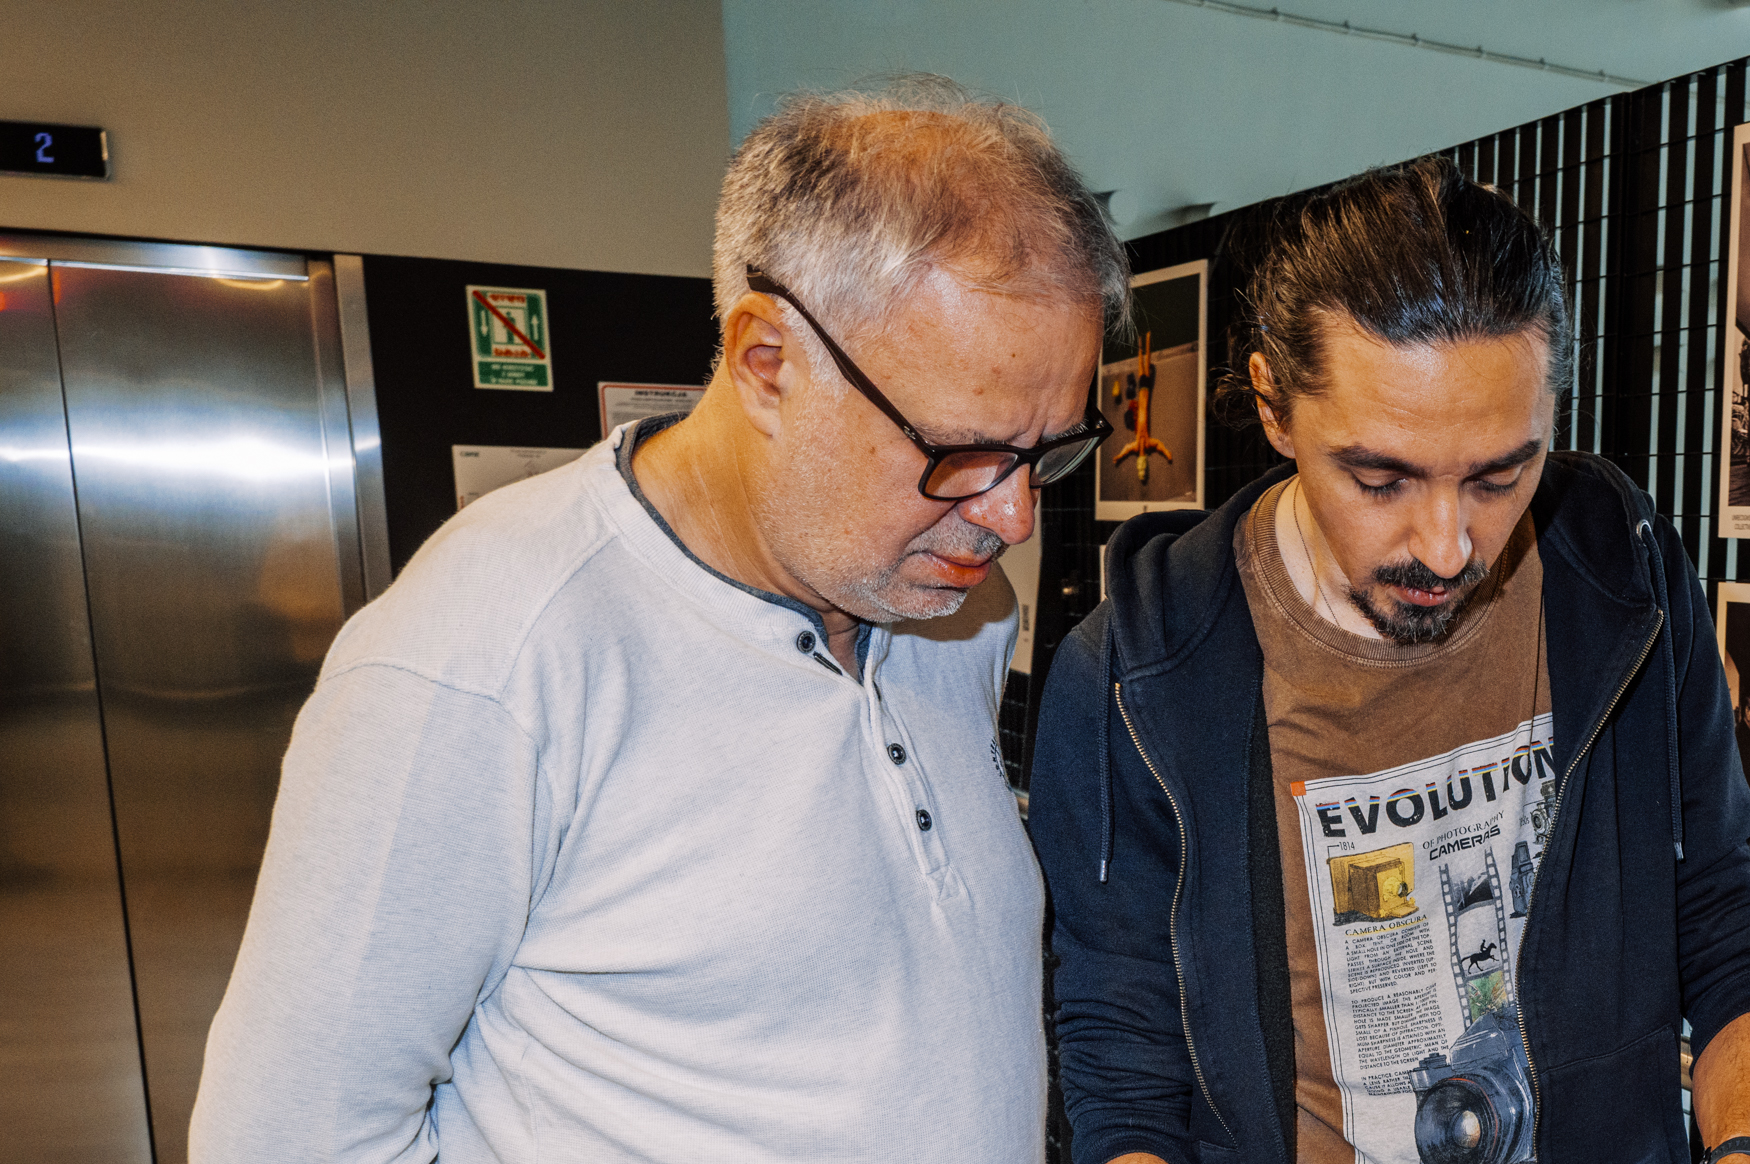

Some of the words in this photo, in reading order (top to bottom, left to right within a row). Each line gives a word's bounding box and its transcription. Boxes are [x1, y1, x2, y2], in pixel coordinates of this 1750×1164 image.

[34, 132, 55, 164] 2
[1315, 736, 1555, 838] EVOLUTION
[1422, 838, 1435, 850] OF
[1436, 809, 1504, 848] PHOTOGRAPHY
[1429, 824, 1501, 861] CAMERAS
[1345, 925, 1386, 935] CAMERA
[1388, 914, 1427, 929] OBSCURA
